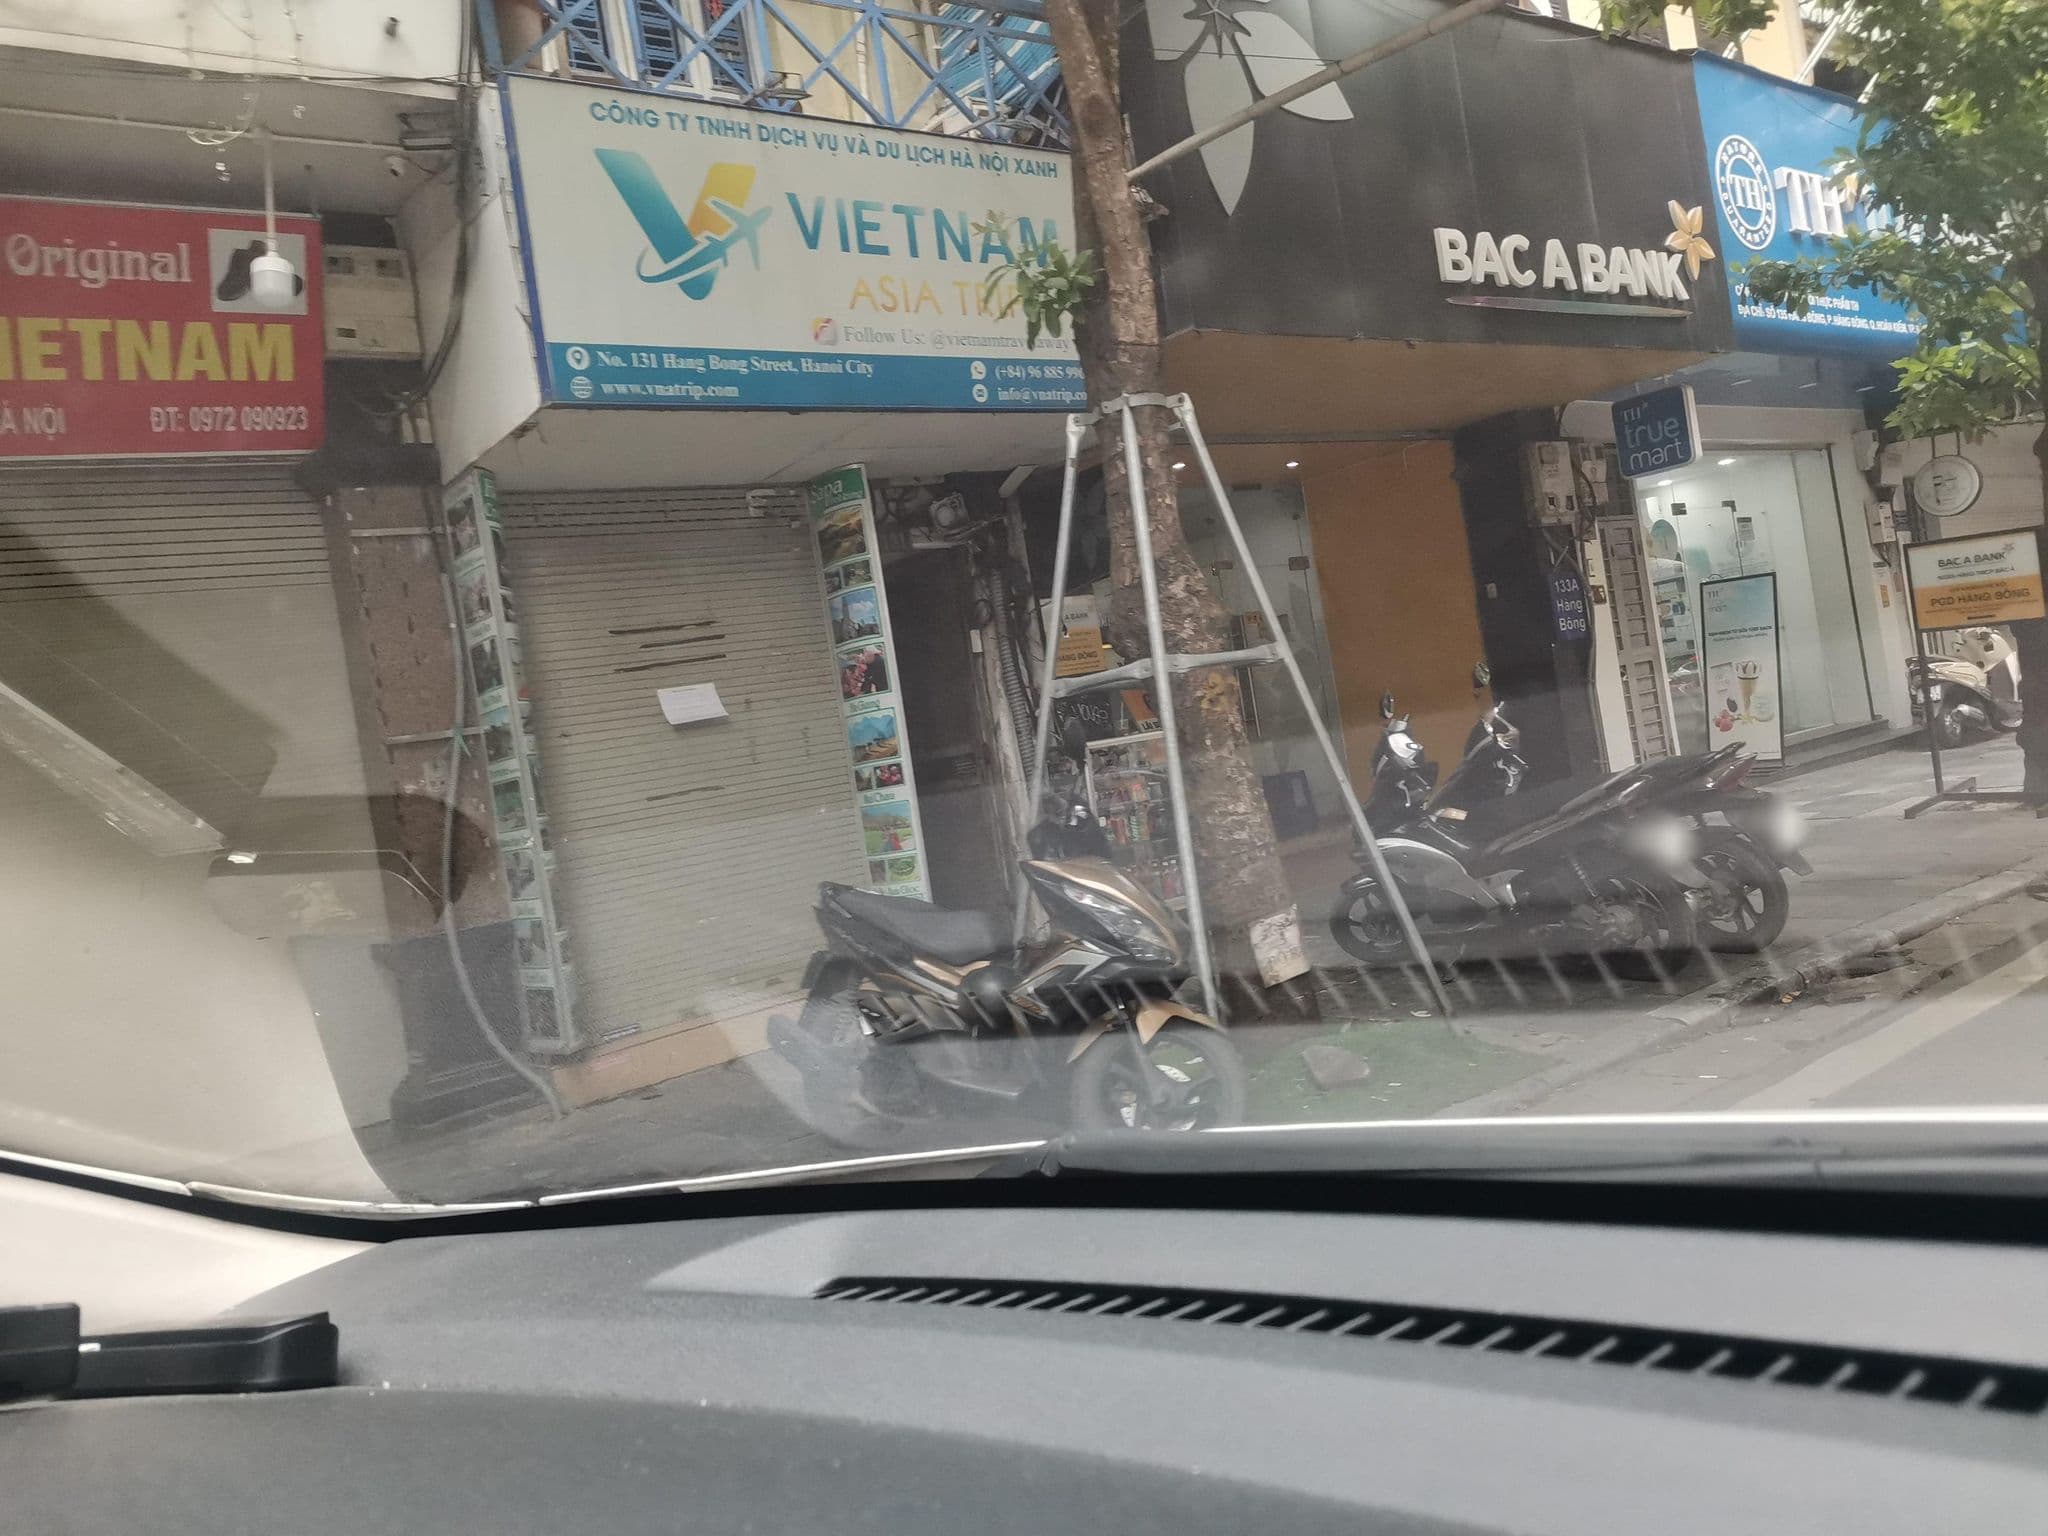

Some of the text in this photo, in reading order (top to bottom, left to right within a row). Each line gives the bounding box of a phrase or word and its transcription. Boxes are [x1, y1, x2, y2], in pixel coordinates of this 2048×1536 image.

[590, 100, 1058, 178] CÔNG TY TNHH DỊCH VỤ VÀ DU LỊCH HÀ NỘI XANH
[1728, 174, 1763, 211] TH
[1773, 166, 1848, 238] TH
[785, 192, 1058, 268] VIETNAM
[6, 233, 192, 288] Original
[1434, 227, 1690, 301] BAC A BANK
[849, 275, 943, 316] ASIA
[843, 326, 895, 344] Follow
[901, 328, 925, 345] Us:
[596, 351, 627, 367] No.
[631, 352, 658, 368] 131
[662, 353, 706, 373] Hang
[708, 354, 749, 374] Bong
[800, 358, 844, 373] Hanoi
[846, 359, 873, 378] City
[998, 387, 1087, 404] info@vnatrip.co
[151, 407, 185, 432] ĐT:
[189, 406, 237, 432] 0972
[1624, 418, 1681, 448] true
[1630, 438, 1685, 470] mart
[1553, 578, 1580, 592] 133A
[1559, 617, 1586, 632] Bông
